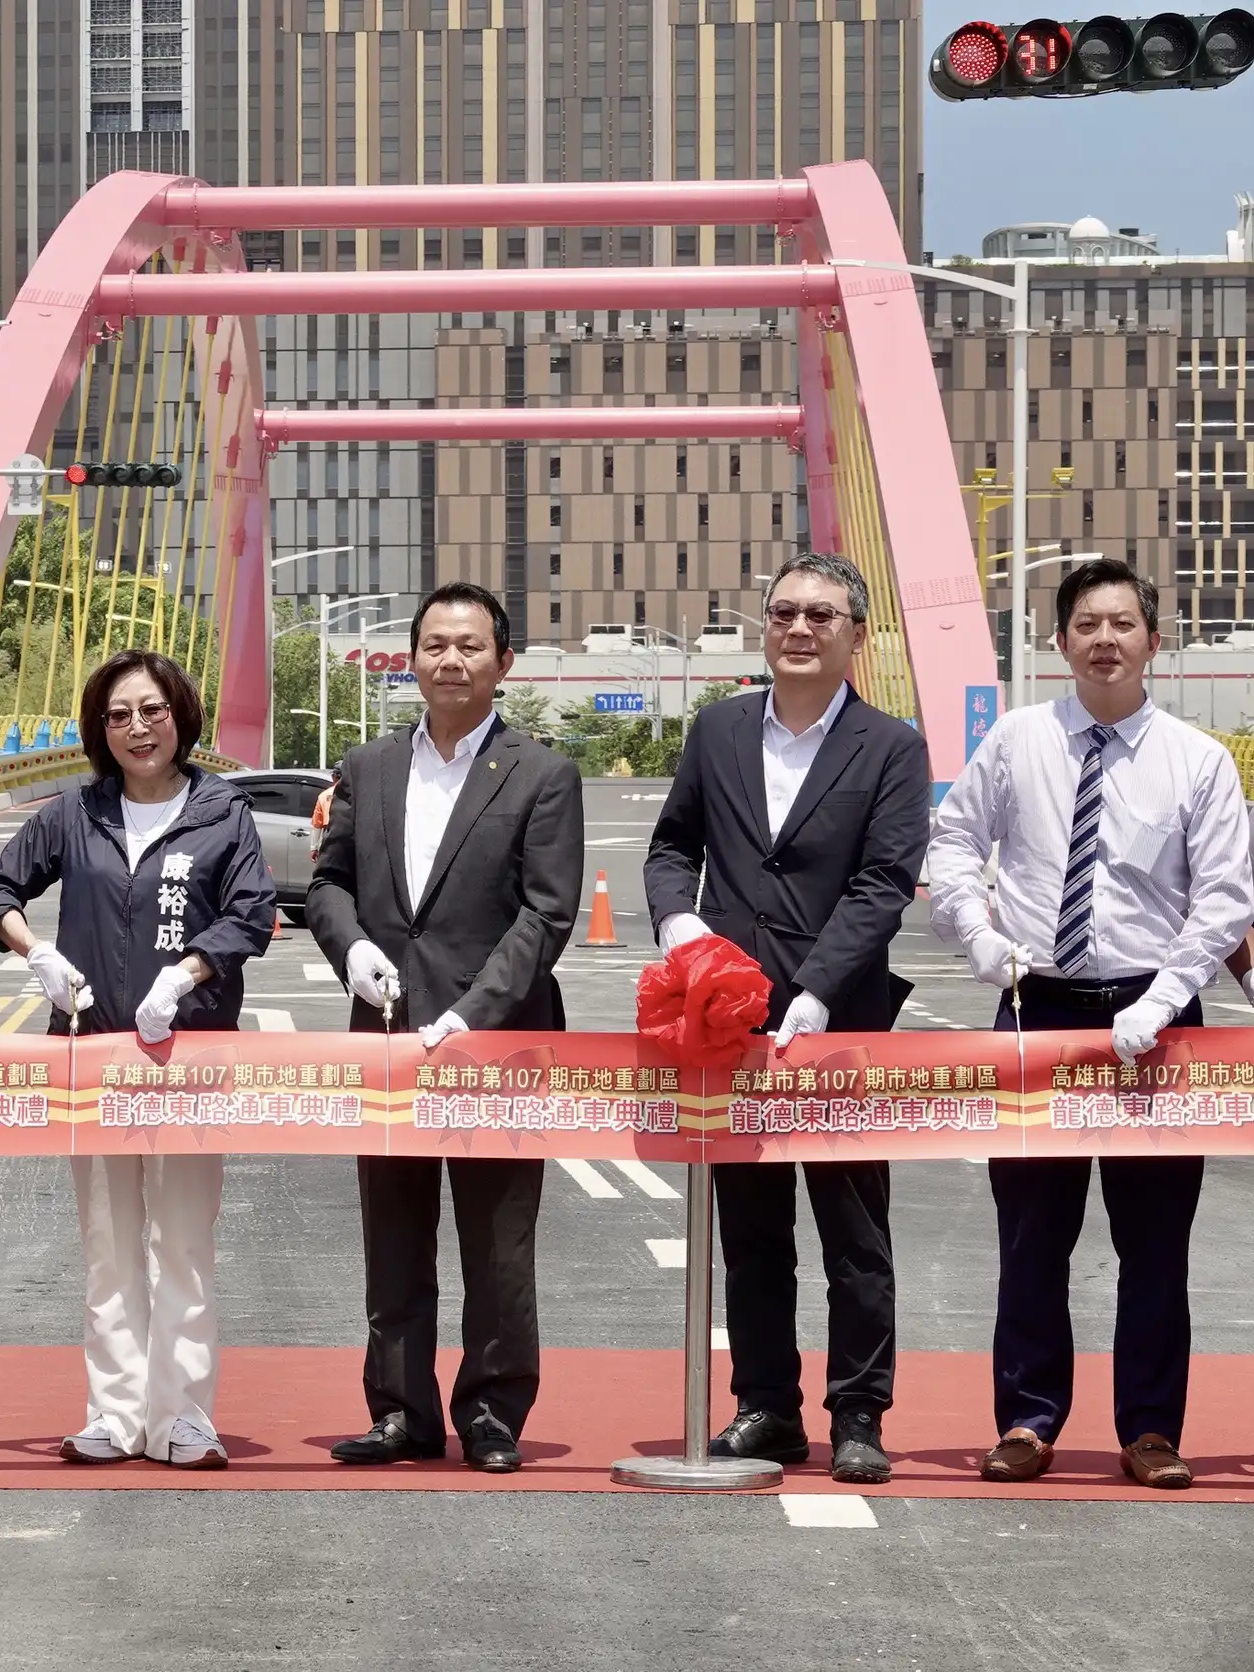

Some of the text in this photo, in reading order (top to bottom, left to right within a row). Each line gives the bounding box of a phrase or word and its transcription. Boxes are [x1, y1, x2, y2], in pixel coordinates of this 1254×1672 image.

[154, 852, 194, 952] 康裕成
[99, 1092, 362, 1127] 龍德東路通車典禮
[413, 1095, 678, 1132] 龍德東路通車典禮
[728, 1096, 998, 1134] 龍德東路通車典禮
[1049, 1092, 1254, 1130] 龍德東路通車
